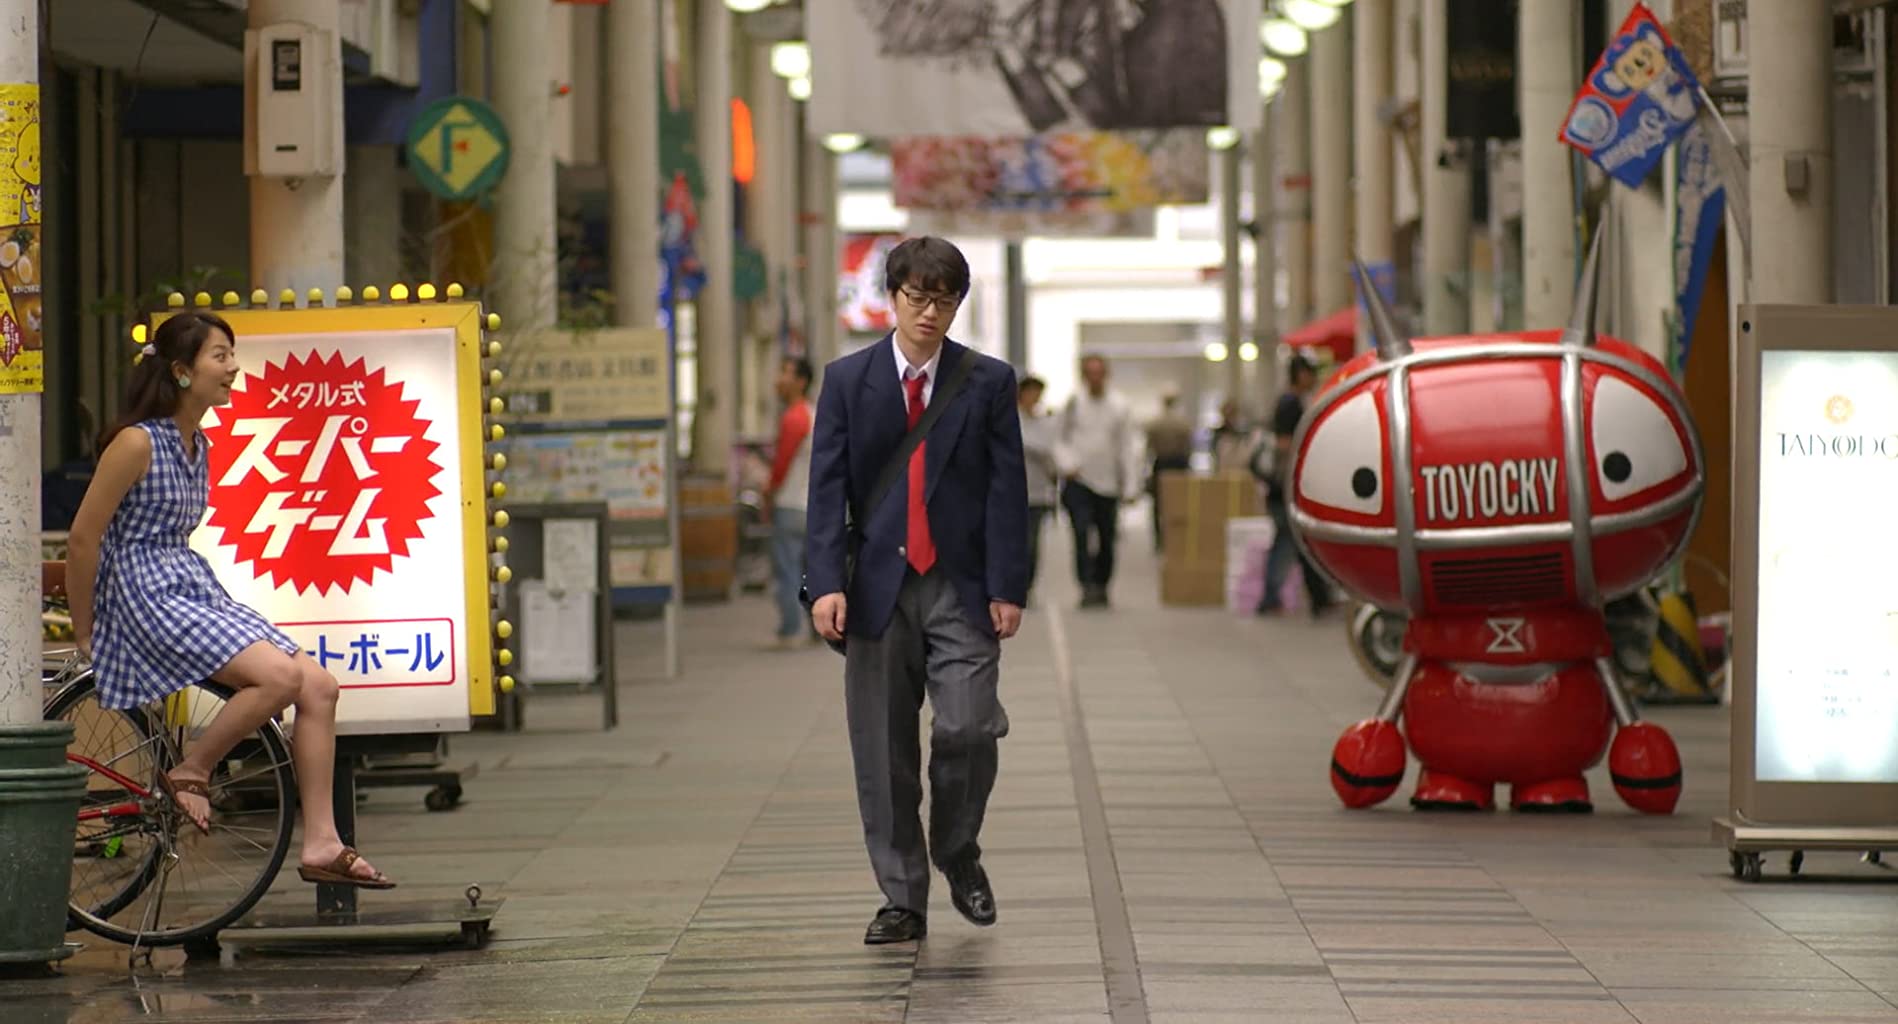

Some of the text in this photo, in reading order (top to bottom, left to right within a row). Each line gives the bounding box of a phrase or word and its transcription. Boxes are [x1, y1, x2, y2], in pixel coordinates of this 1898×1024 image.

[267, 380, 366, 409] メタル式
[217, 415, 412, 486] スーパー
[1421, 457, 1557, 521] TOYOCKY
[244, 488, 390, 558] ゲーム
